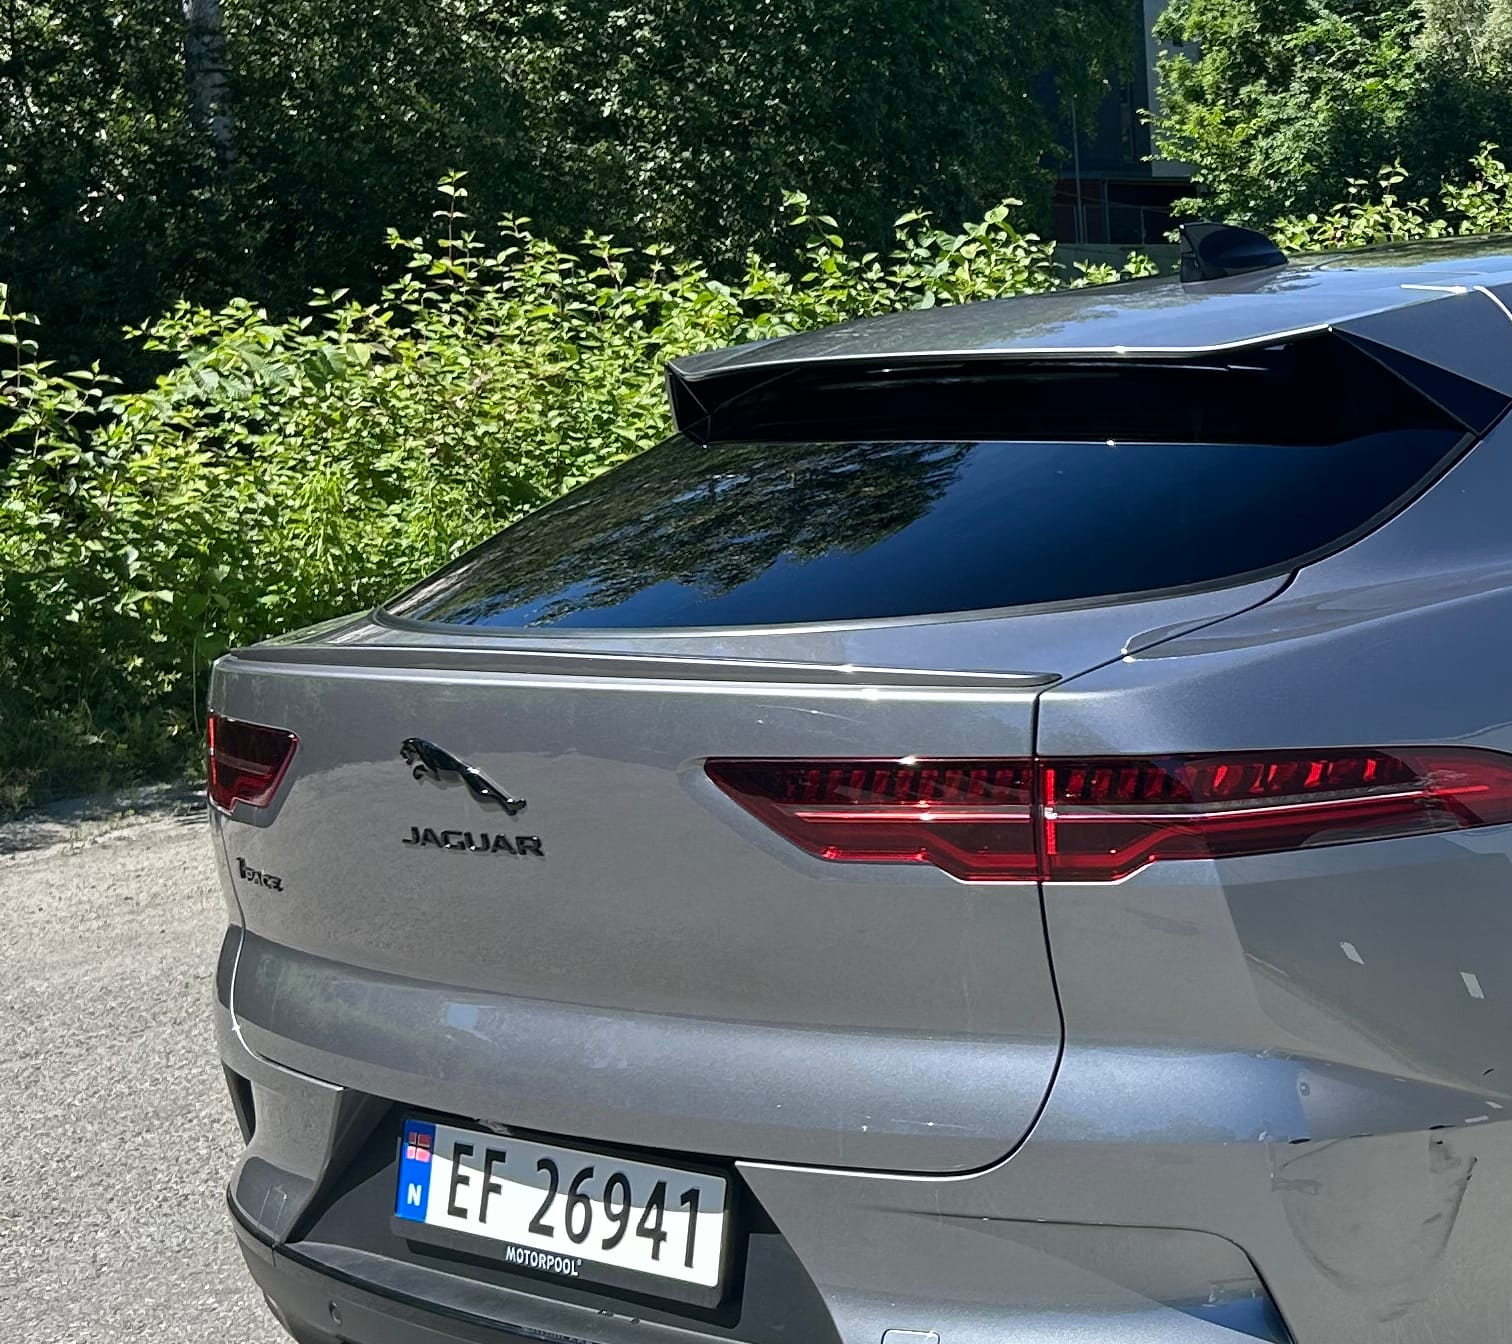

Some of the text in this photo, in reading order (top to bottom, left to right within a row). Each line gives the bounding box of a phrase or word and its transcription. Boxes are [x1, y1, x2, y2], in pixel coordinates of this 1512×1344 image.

[402, 826, 545, 857] JAGUAR
[407, 1183, 421, 1206] N
[447, 1142, 701, 1269] EF 26941
